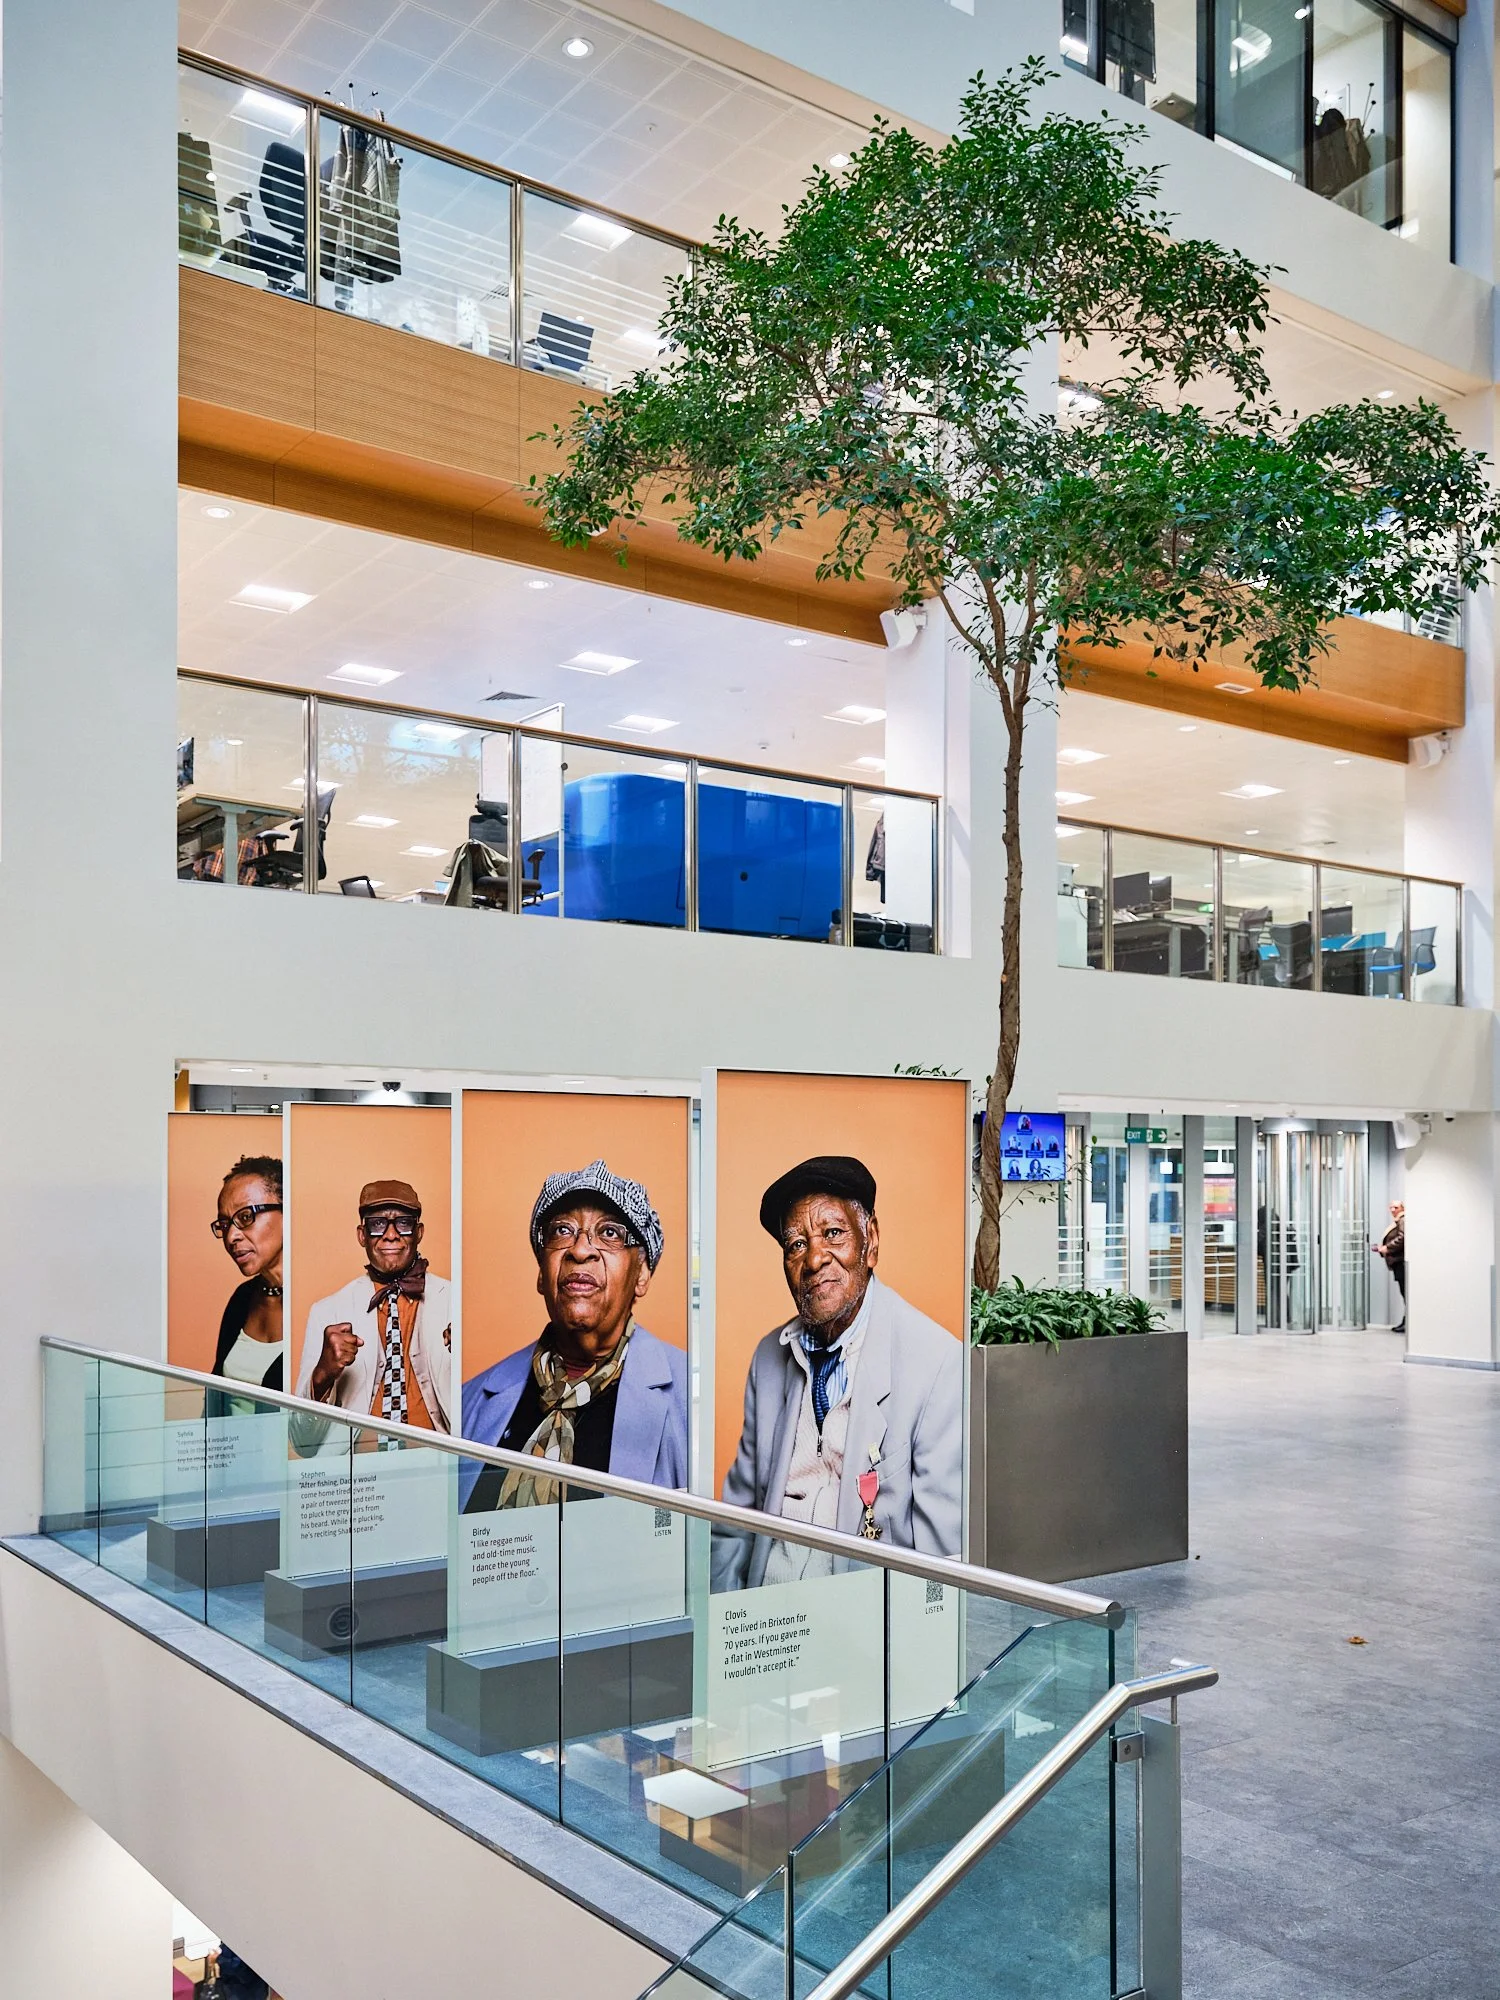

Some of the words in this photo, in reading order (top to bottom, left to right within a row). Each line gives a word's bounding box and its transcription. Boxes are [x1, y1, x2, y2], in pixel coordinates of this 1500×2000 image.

[1127, 1131, 1141, 1139] EXIT
[300, 1471, 326, 1479] Stephen
[306, 1502, 317, 1510] pair
[308, 1510, 324, 1519] pluck
[325, 1508, 335, 1516] the
[336, 1509, 349, 1517] grey
[365, 1504, 379, 1512] from
[311, 1520, 329, 1528] beard.
[331, 1518, 348, 1526] While
[314, 1529, 337, 1538] reciting
[473, 1527, 490, 1536] Birdy
[490, 1537, 513, 1547] reggae
[514, 1534, 533, 1543] music
[473, 1552, 485, 1560] and
[486, 1548, 515, 1558] old-time
[517, 1545, 537, 1554] music.
[476, 1563, 496, 1572] dance
[498, 1561, 509, 1569] the
[510, 1559, 530, 1569] young
[473, 1574, 495, 1586] people
[496, 1572, 506, 1581] off
[507, 1571, 518, 1580] the
[725, 1609, 747, 1620] Clovis
[926, 1605, 943, 1614] LISTEN
[740, 1621, 758, 1632] lived
[760, 1620, 766, 1629] in
[768, 1616, 795, 1627] Brixton
[797, 1614, 807, 1622] for
[724, 1641, 733, 1650] 70
[735, 1638, 757, 1650] years.
[759, 1634, 764, 1644] If
[766, 1634, 779, 1644] you
[780, 1630, 797, 1642] gave
[799, 1628, 810, 1636] me
[725, 1657, 728, 1665] a
[731, 1654, 743, 1663] flat
[745, 1652, 752, 1661] in
[754, 1644, 801, 1659] Westminster
[724, 1671, 727, 1679] I
[729, 1665, 761, 1679] wouldn't
[763, 1660, 787, 1672] accept
